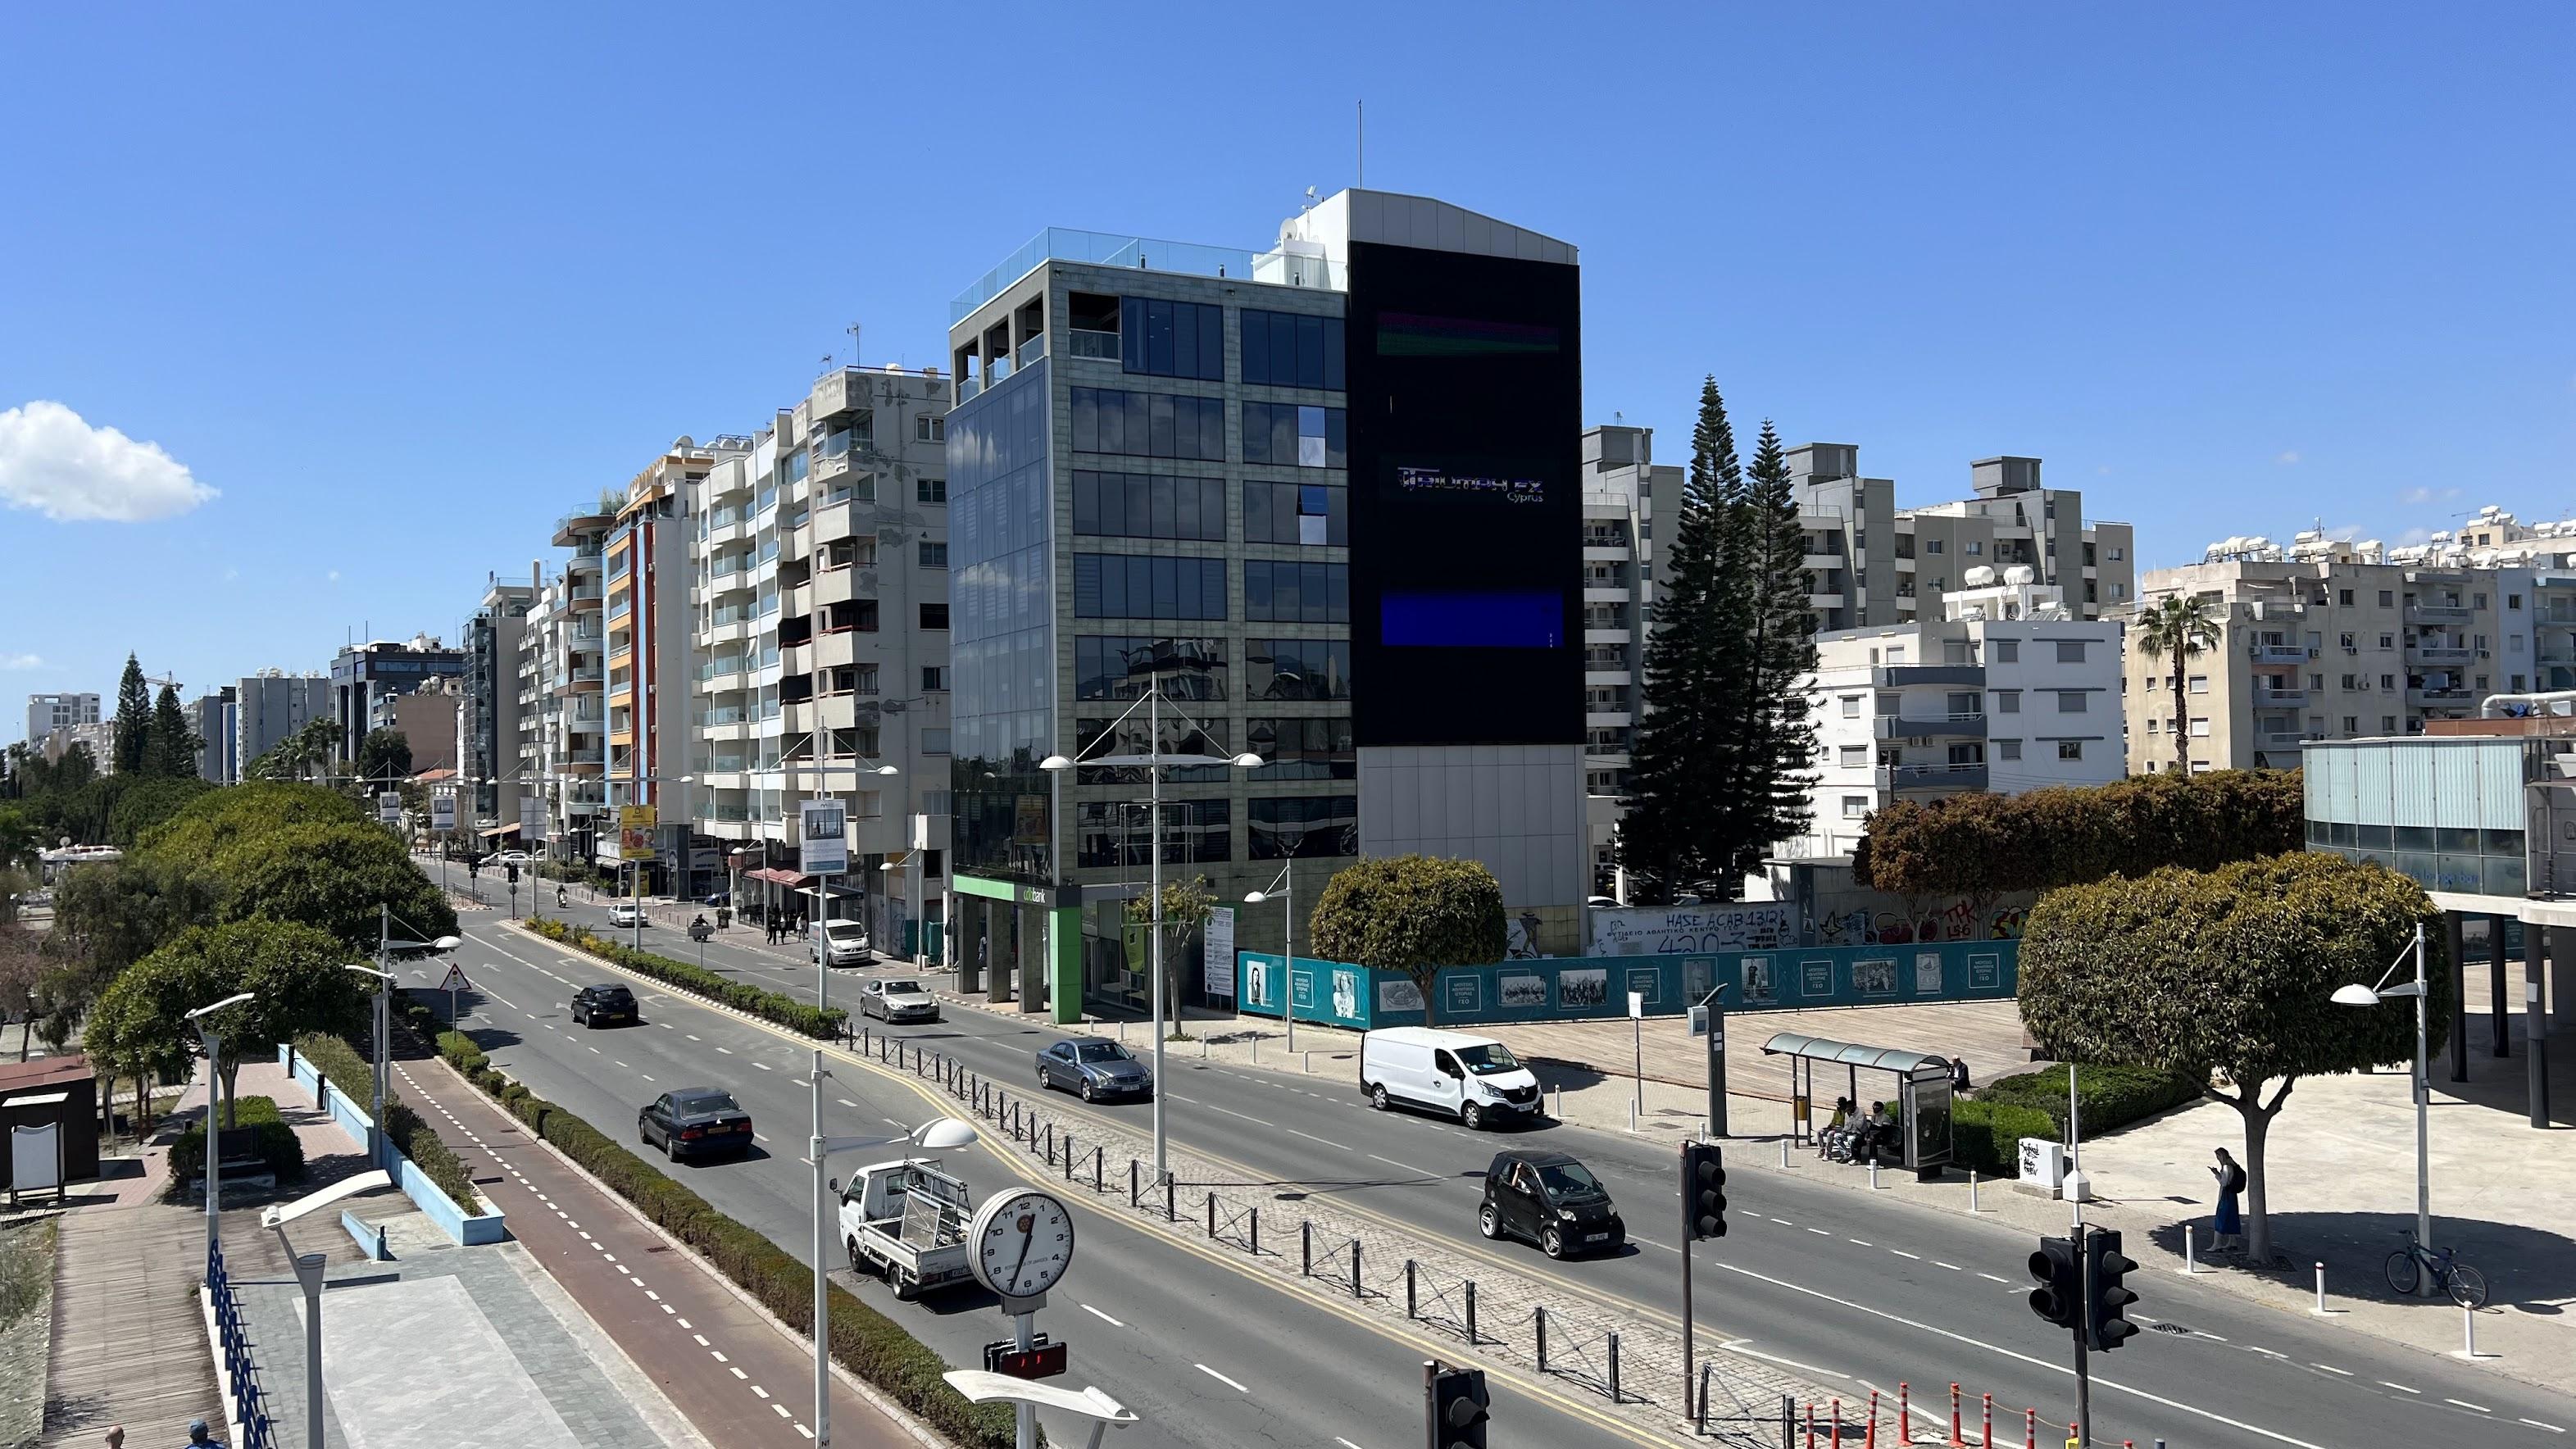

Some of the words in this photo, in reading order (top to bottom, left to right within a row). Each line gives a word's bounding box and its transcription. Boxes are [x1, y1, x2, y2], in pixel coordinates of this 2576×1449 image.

[1506, 491, 1544, 504] Cyprus
[1708, 913, 1745, 928] ACAB
[1689, 925, 1720, 933] ΚΕΝΤΡΟ
[1017, 1202, 1031, 1211] 12
[1002, 1211, 1013, 1220] 11
[1051, 1216, 1058, 1224] 2
[990, 1229, 1003, 1237] 10
[1056, 1233, 1064, 1242] 3
[987, 1248, 995, 1256] 9
[1052, 1253, 1060, 1261] 4
[993, 1266, 1002, 1274] 8
[1040, 1270, 1048, 1279] 5
[1024, 1279, 1032, 1288] 6
